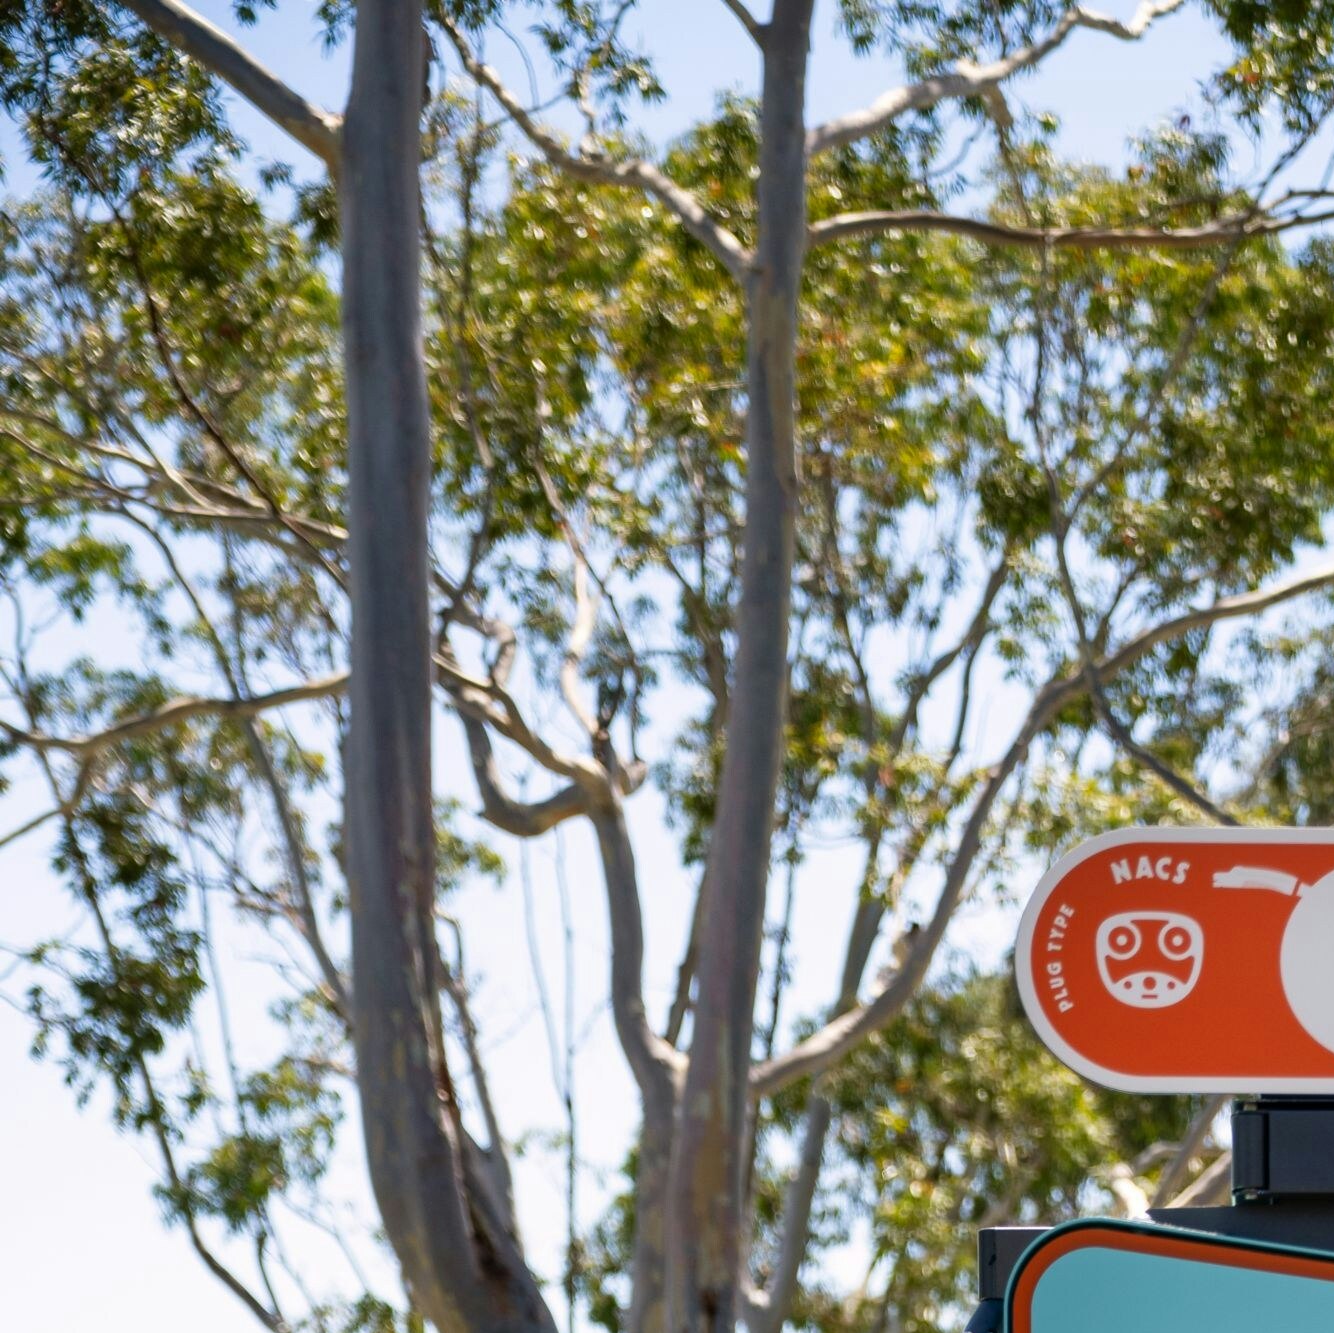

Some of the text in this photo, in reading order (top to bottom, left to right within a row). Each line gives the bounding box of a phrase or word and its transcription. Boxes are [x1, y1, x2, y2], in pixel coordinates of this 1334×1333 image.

[1110, 856, 1190, 885] NACS
[1047, 903, 1075, 1013] PLUG TYPE
